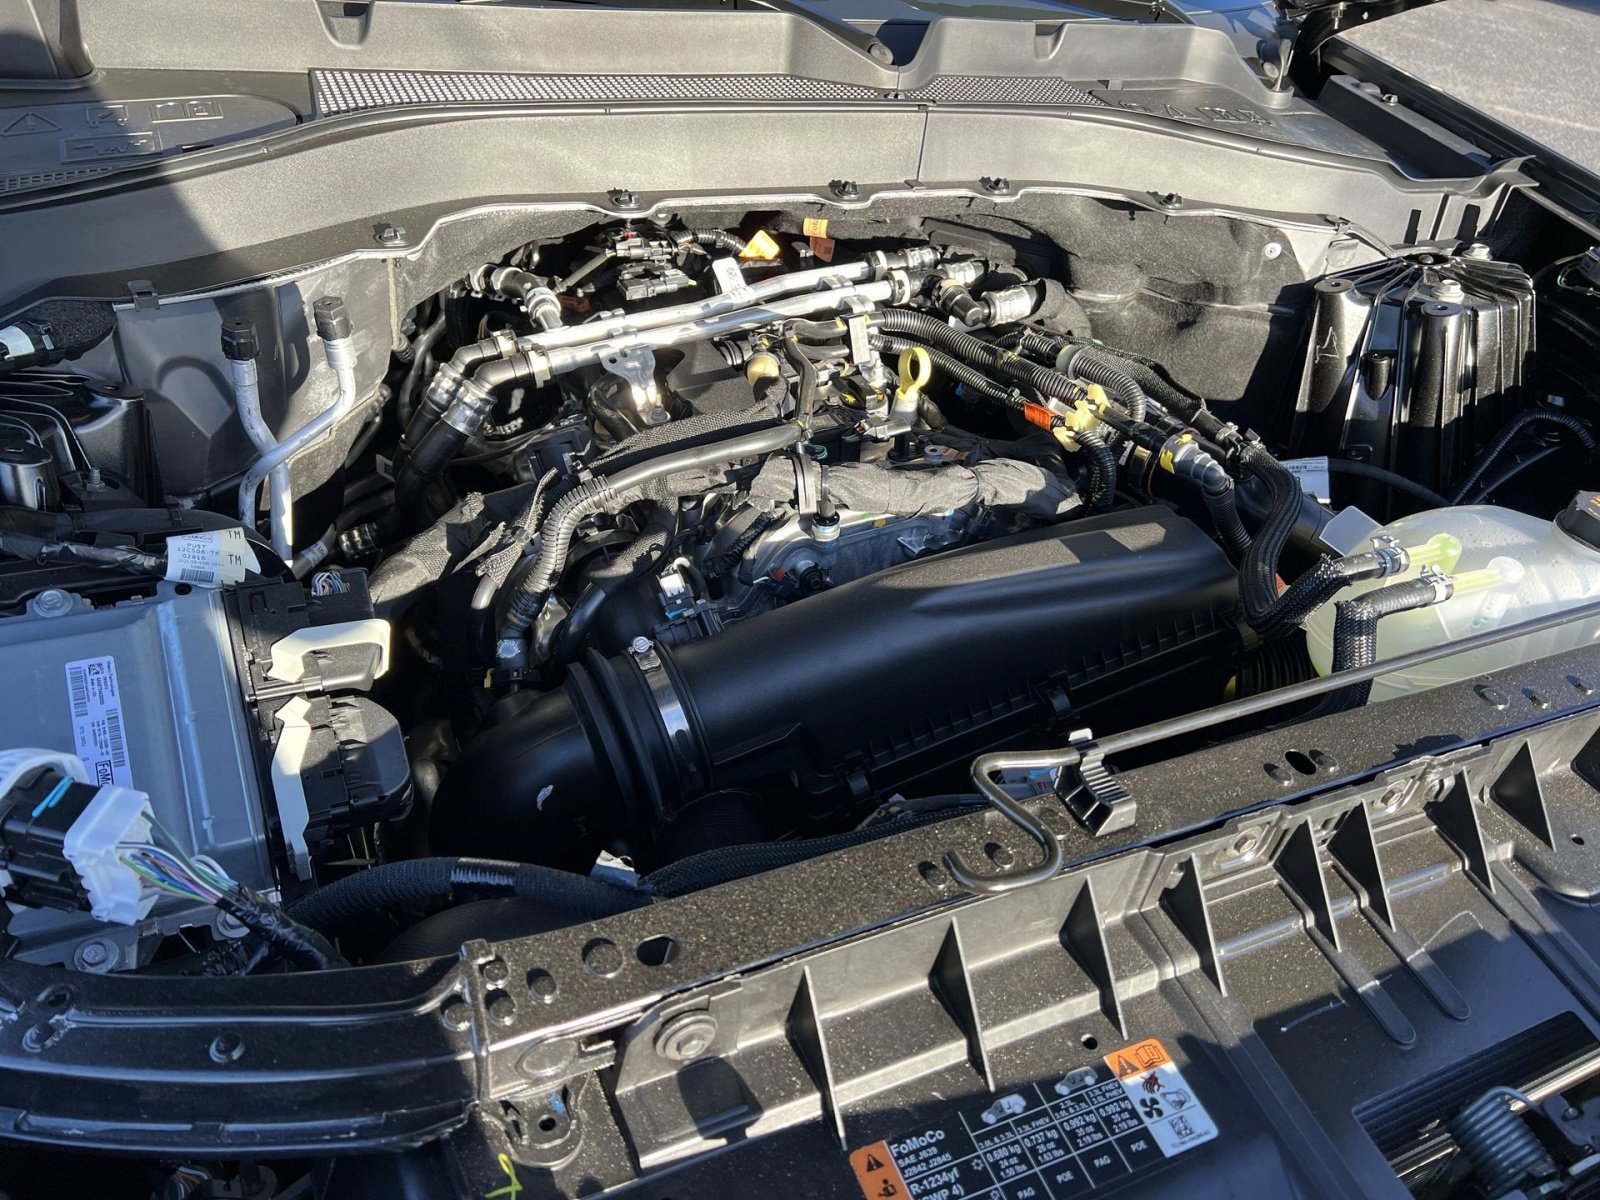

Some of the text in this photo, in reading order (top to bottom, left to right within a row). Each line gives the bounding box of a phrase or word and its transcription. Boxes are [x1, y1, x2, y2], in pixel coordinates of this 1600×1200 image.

[228, 530, 241, 540] TM
[228, 554, 242, 566] TM
[1088, 1088, 1102, 1098] 3.3L
[1105, 1087, 1123, 1099] PHEV
[1098, 1100, 1132, 1118] 0.992 kg
[1120, 1111, 1131, 1120] oz
[1063, 1113, 1097, 1131] 0.992 kg
[1126, 1118, 1139, 1128] lbs
[1085, 1125, 1095, 1133] oz
[890, 1130, 945, 1157] FoMoCo
[1024, 1129, 1059, 1148] 0.737 kg
[1091, 1132, 1103, 1142] lbs
[1008, 1144, 1022, 1154] kg
[1046, 1141, 1056, 1150] oz
[1130, 1139, 1148, 1153] POE
[898, 1146, 938, 1168] SAE J639
[1052, 1148, 1065, 1159] lbs
[904, 1152, 952, 1178] J2842 J2845
[999, 1156, 1019, 1169] 24 oz
[1093, 1155, 1111, 1168] PAG
[1000, 1164, 1028, 1179] 1.50 lbs
[1056, 1170, 1074, 1184] POE
[909, 1166, 960, 1196] R-1234yf
[952, 1183, 965, 1197] 4)
[1017, 1186, 1036, 1200] PAG
